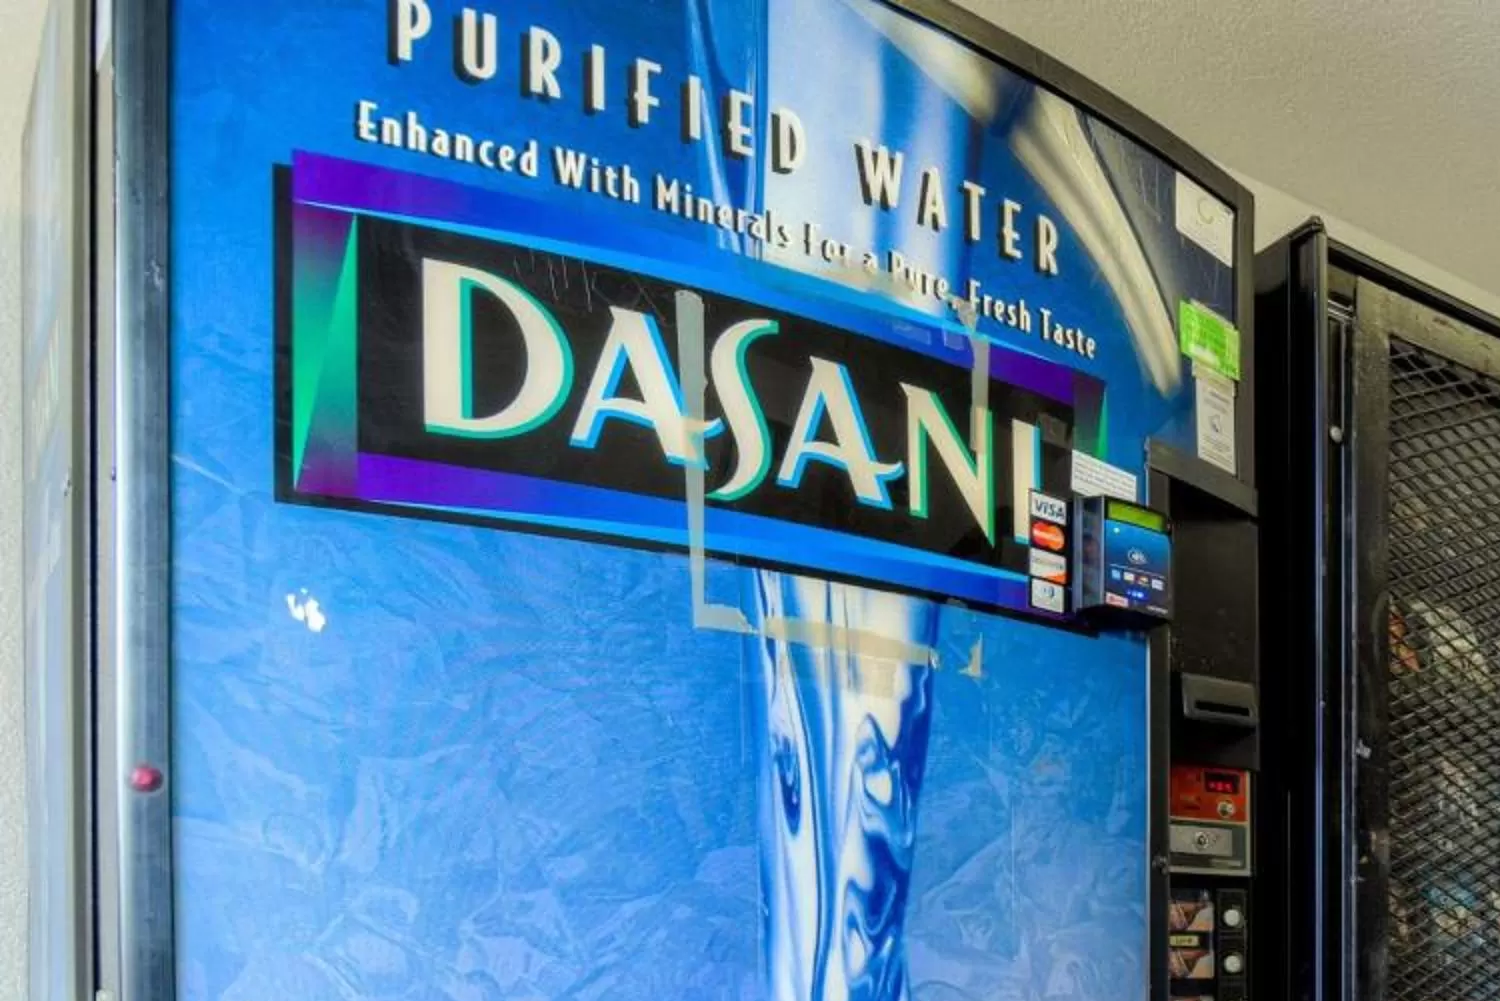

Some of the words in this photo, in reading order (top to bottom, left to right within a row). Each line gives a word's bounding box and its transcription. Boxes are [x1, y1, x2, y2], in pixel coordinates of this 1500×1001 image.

[355, 99, 538, 178] Enhanced
[553, 145, 641, 204] With
[656, 173, 792, 247] Minerals
[804, 222, 850, 267] For
[862, 251, 878, 275] a
[967, 278, 1031, 334] Fresh
[1040, 307, 1096, 361] Taste
[389, 0, 807, 175] PURIFIED
[854, 138, 1060, 278] WATER
[422, 256, 1041, 549] DASANI
[1035, 500, 1065, 519] VISA
